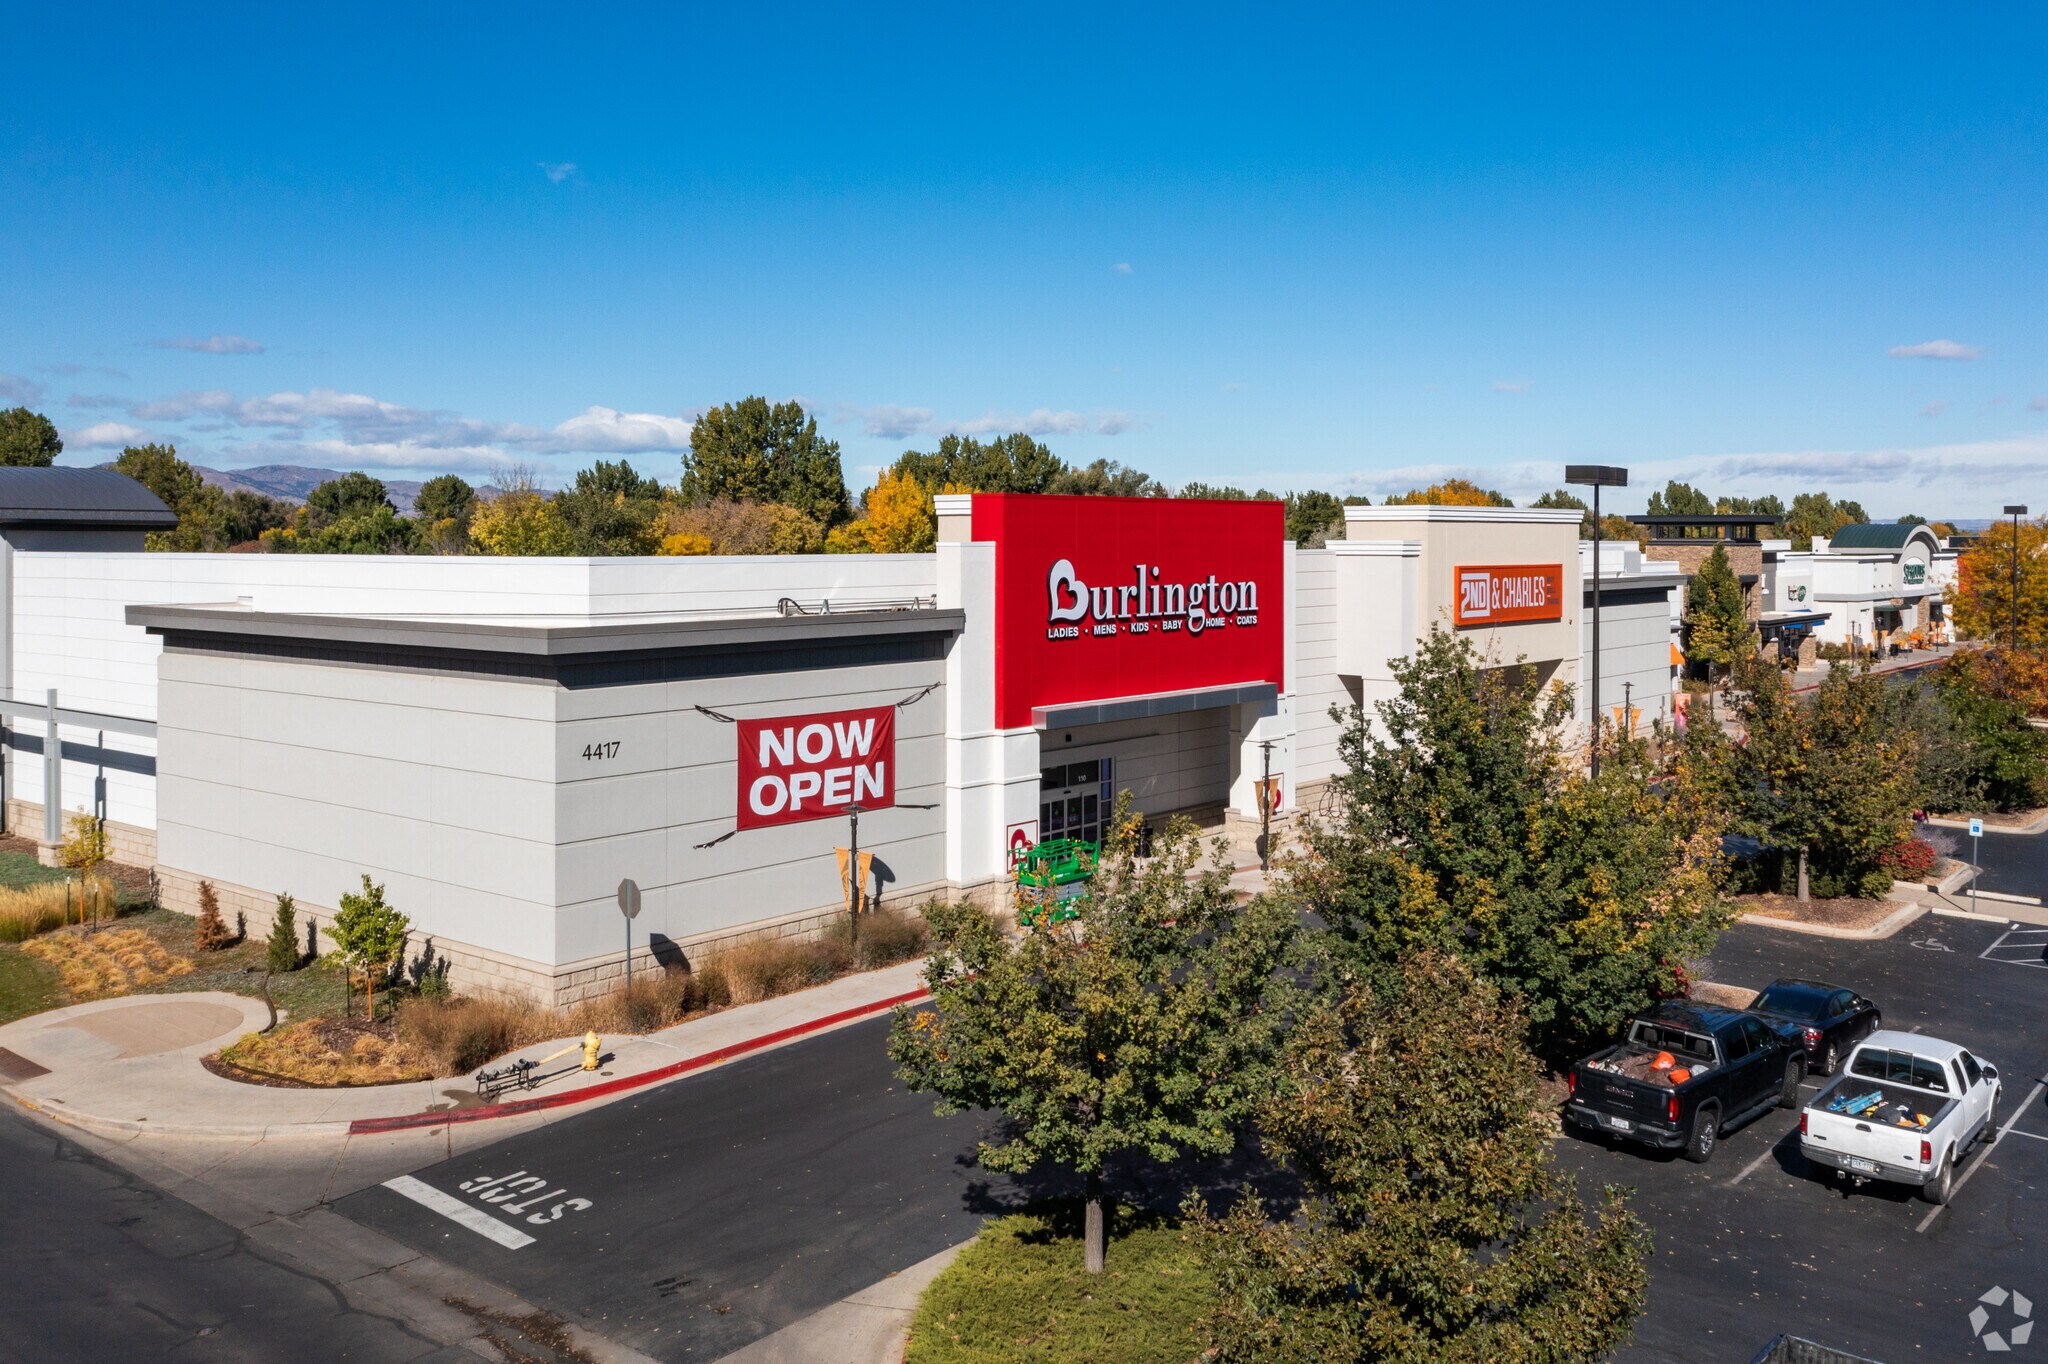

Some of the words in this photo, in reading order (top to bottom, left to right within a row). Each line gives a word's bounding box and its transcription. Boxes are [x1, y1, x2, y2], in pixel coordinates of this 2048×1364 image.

[1048, 558, 1258, 633] Burlington
[1461, 580, 1488, 617] 2ND
[1491, 577, 1500, 609] &
[1502, 576, 1545, 609] CHARLES
[1048, 626, 1079, 639] LADIES
[1093, 624, 1117, 636] MENS
[1130, 622, 1149, 634] KIDS
[1162, 619, 1182, 631] BABY
[1205, 617, 1226, 628] HOME
[1236, 615, 1258, 626] COATS
[582, 741, 621, 761] 4417
[759, 717, 876, 769] NOW
[749, 761, 885, 817] OPEN
[458, 1170, 593, 1225] STOP
